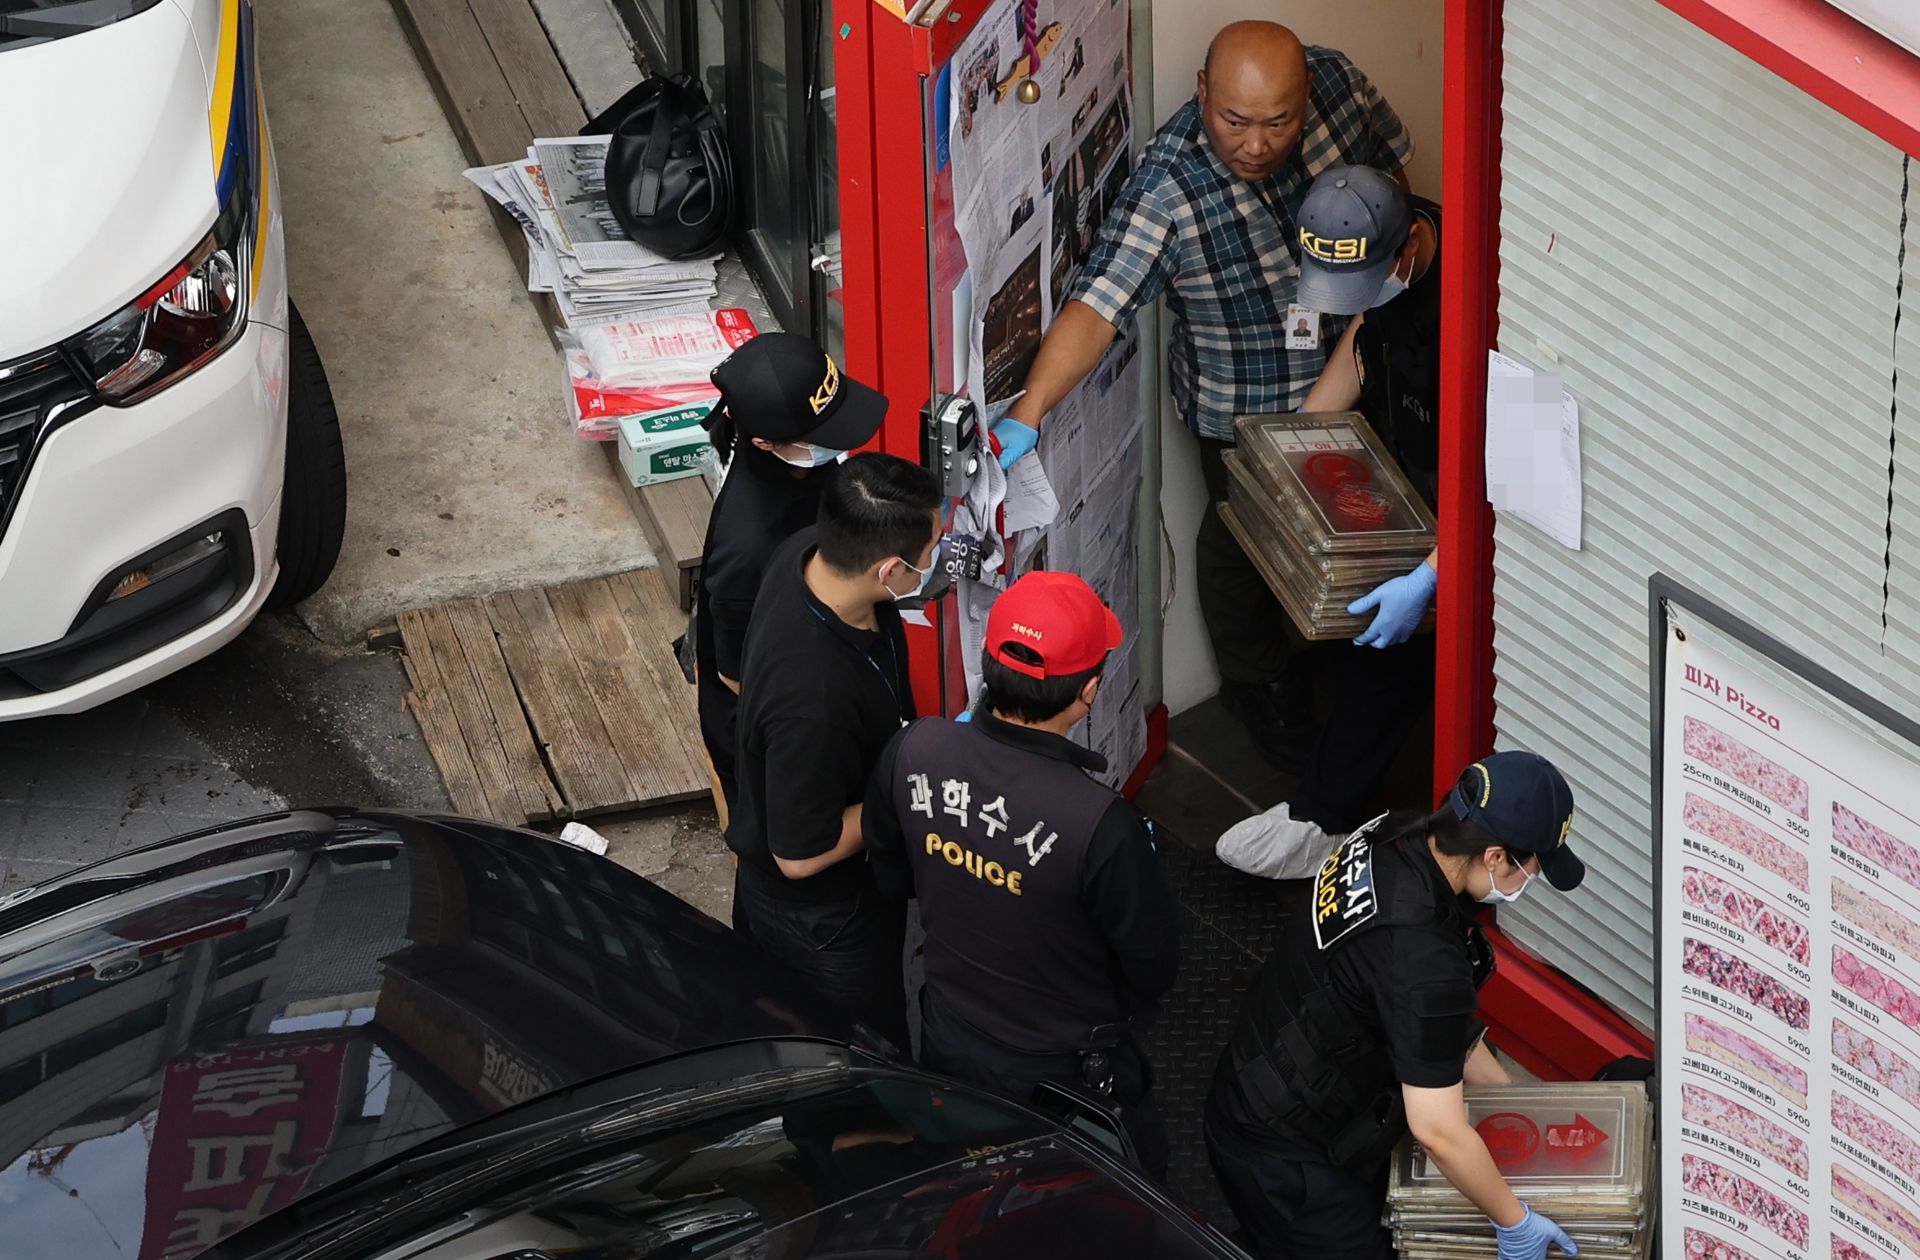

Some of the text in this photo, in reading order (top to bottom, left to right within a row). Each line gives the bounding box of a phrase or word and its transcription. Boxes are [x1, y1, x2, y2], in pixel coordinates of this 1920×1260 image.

[1300, 227, 1367, 258] KCSI
[809, 354, 839, 415] KCS
[1403, 394, 1430, 423] KCSI
[1011, 622, 1042, 640] 과학수사
[1685, 664, 1780, 731] 피자 Pizza
[1683, 763, 1711, 782] 25cm
[907, 773, 1058, 867] 과학수사
[1786, 819, 1809, 838] 3500
[925, 833, 1022, 895] POLICE
[1787, 893, 1810, 911] 4900
[1831, 920, 1895, 962] 스위트고구마피자
[1787, 963, 1811, 982] 5900
[1682, 985, 1752, 1021] 스위트불고기피자
[1788, 1036, 1810, 1055] 5900
[1787, 1108, 1810, 1127] 5900
[1787, 1179, 1809, 1198] 6400
[1831, 1205, 1899, 1255] 더블치즈베이컨피자
